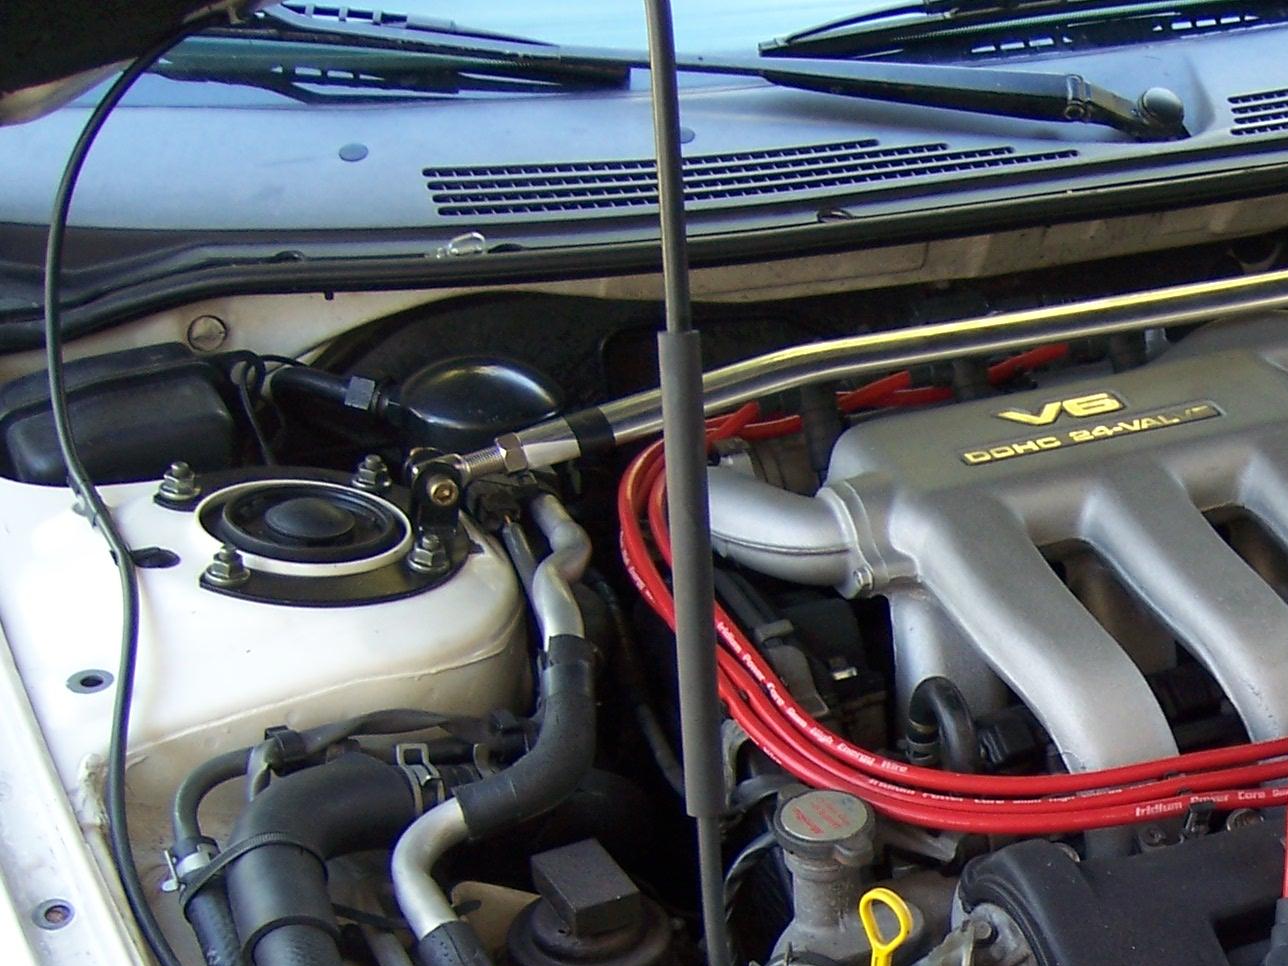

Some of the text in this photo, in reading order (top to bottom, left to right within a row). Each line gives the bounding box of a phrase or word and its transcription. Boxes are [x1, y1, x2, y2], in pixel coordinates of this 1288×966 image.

[997, 392, 1126, 426] V6
[963, 436, 1062, 465] DOHC
[1135, 800, 1183, 817] Iridium
